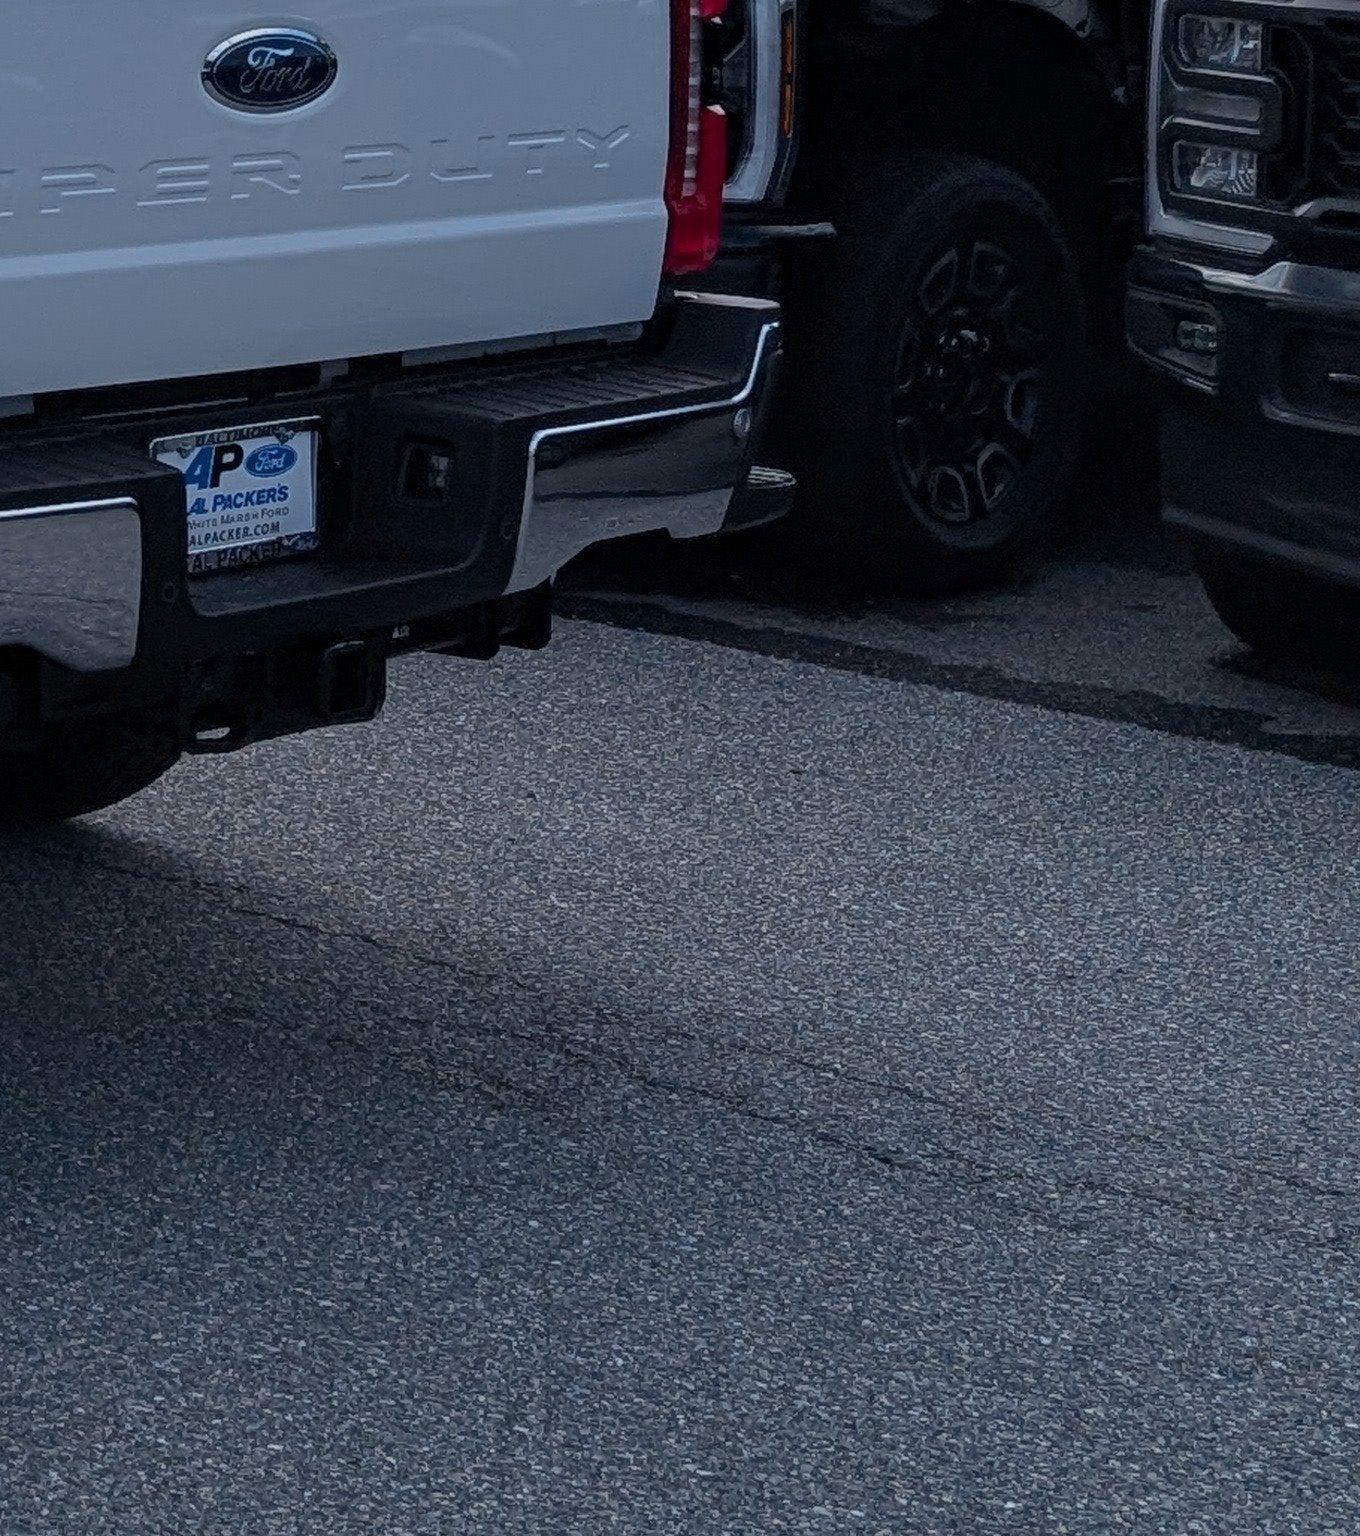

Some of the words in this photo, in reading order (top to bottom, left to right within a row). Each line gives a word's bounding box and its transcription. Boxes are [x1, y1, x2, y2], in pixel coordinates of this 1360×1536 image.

[240, 47, 311, 93] Ford
[342, 125, 631, 192] DUTY
[183, 443, 244, 490] AP
[212, 483, 290, 511] PACKER'S
[189, 521, 280, 547] ALPACKER.COM
[220, 513, 259, 525] MARSH
[261, 507, 290, 519] FORD
